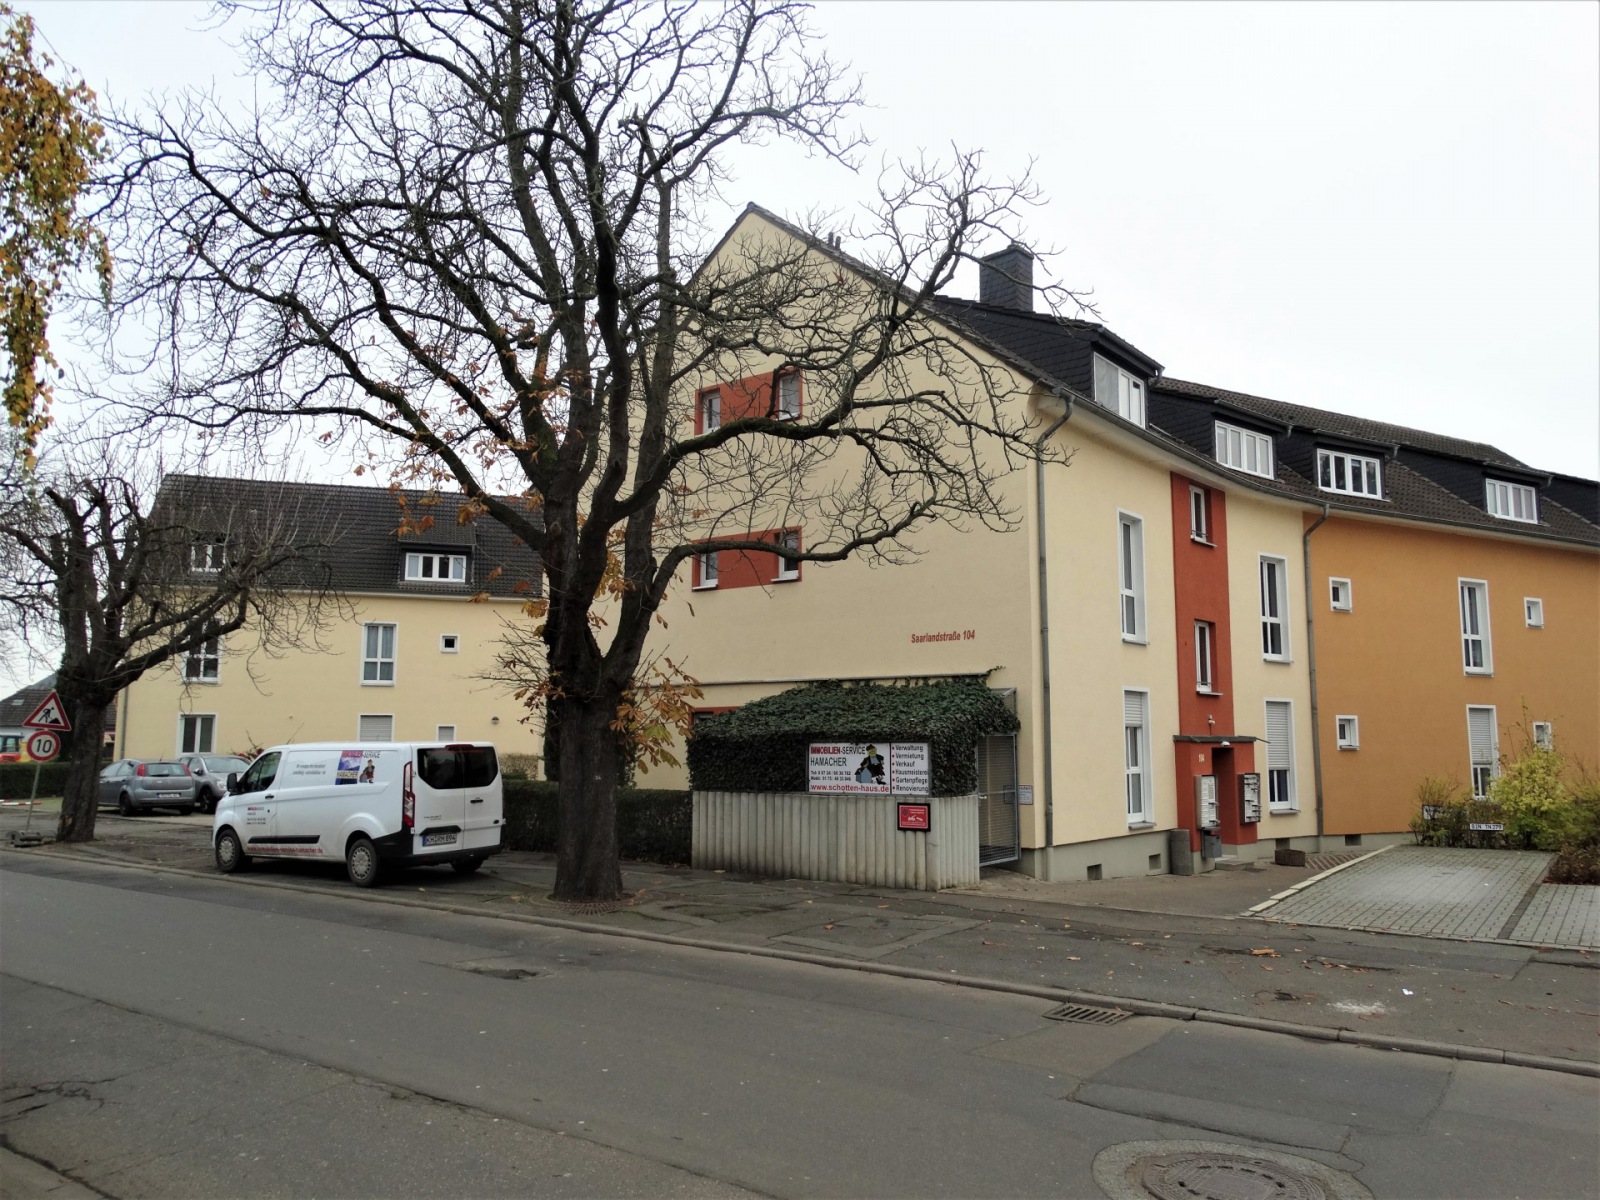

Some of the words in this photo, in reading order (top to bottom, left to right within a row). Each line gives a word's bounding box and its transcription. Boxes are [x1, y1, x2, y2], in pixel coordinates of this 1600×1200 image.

[911, 630, 961, 643] Saarlandstraße
[963, 629, 976, 640] 104
[37, 738, 52, 753] 10
[810, 746, 866, 755] IMMOBILIEN-SERVICE
[810, 757, 847, 767] HAMACHER
[896, 777, 928, 785] Gartenpflege
[811, 784, 889, 793] www.schotten-haus.de
[896, 785, 929, 793] Renovierung
